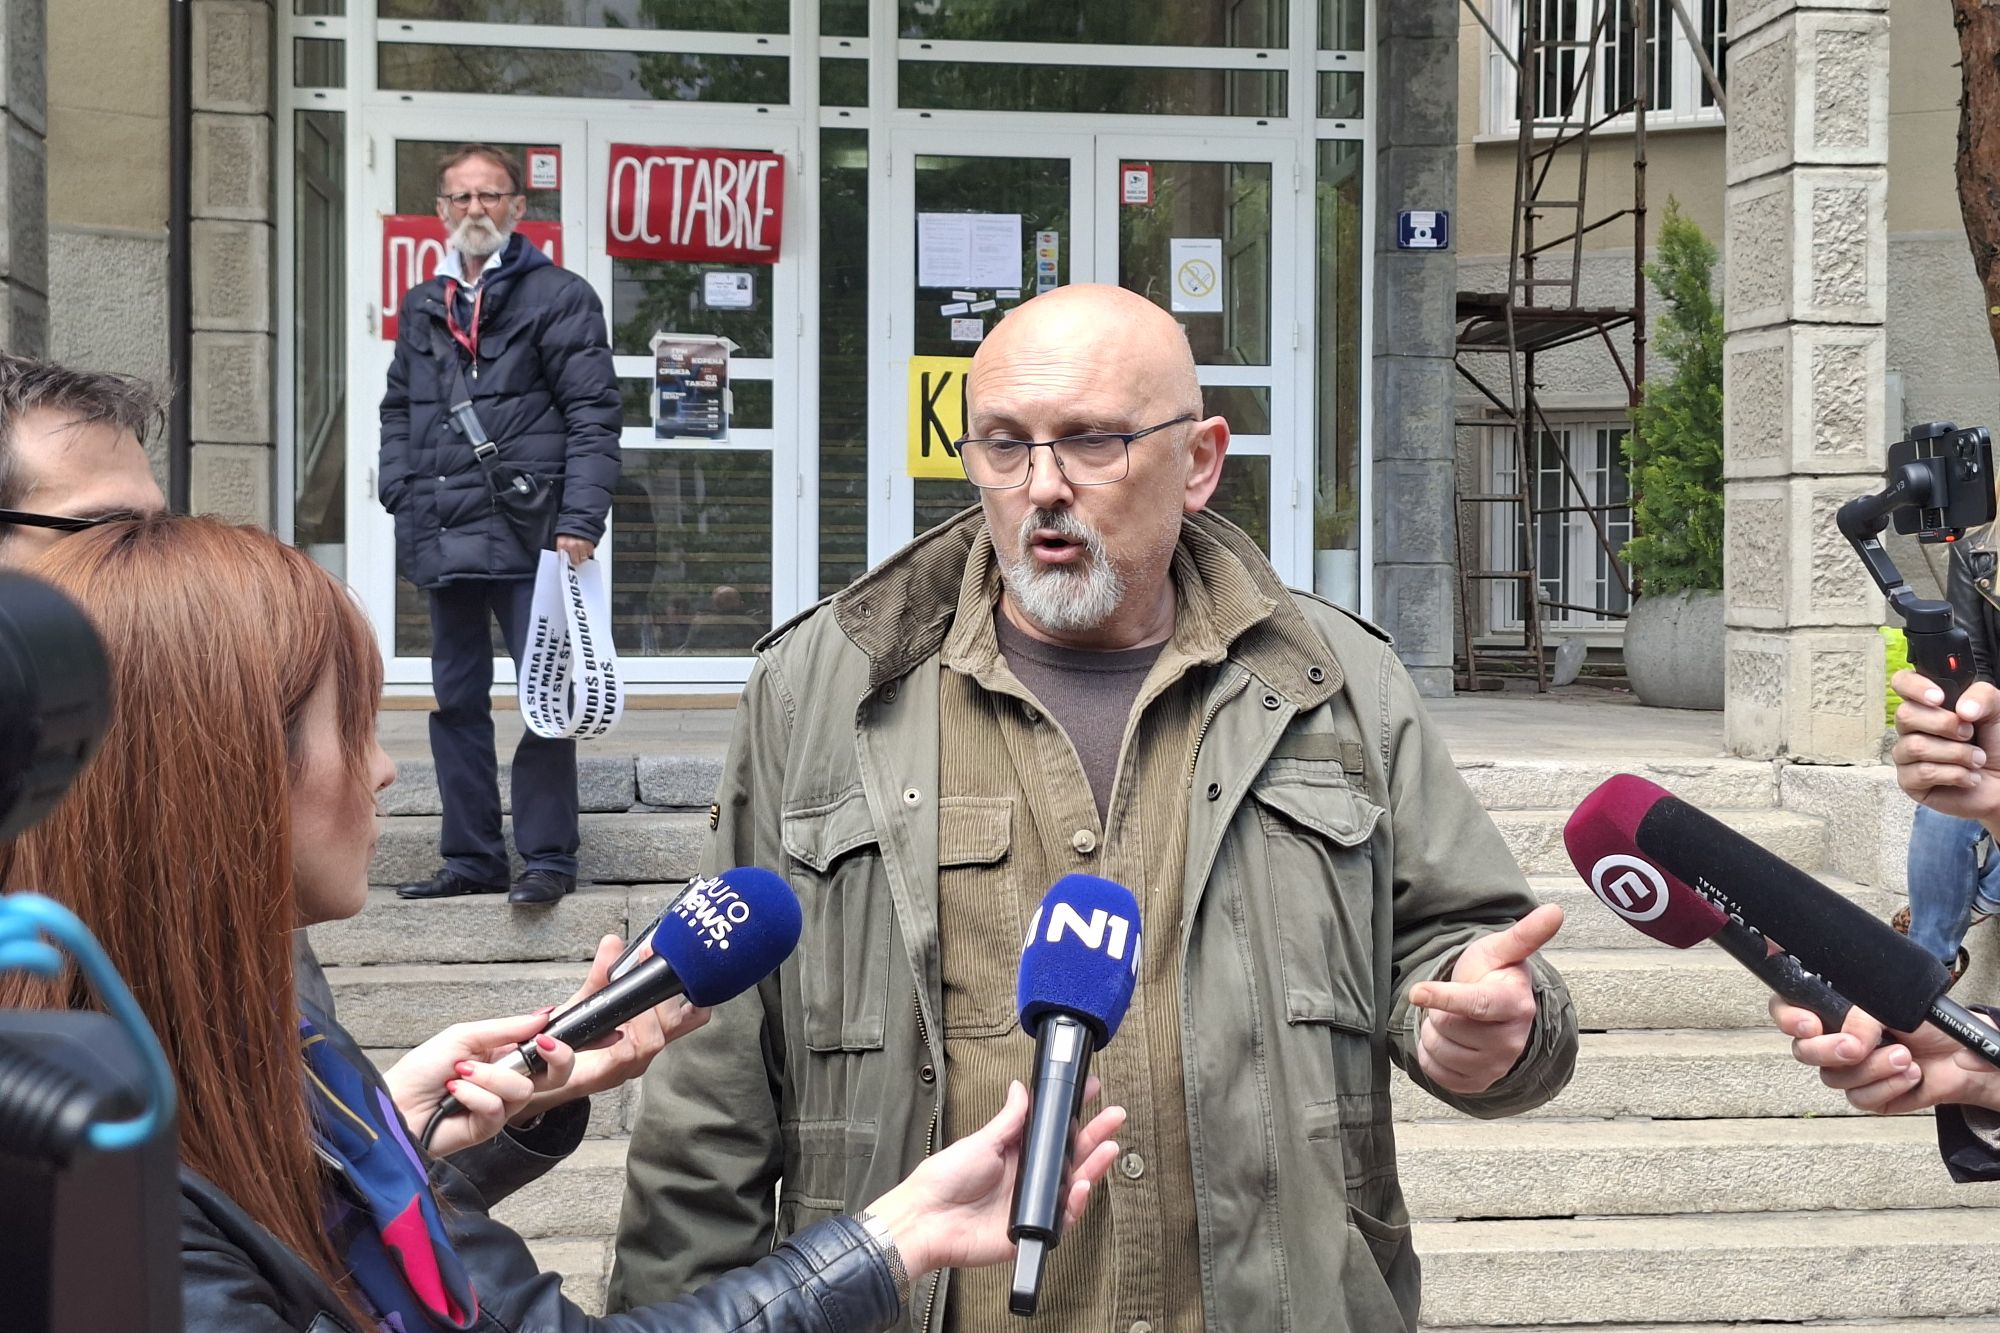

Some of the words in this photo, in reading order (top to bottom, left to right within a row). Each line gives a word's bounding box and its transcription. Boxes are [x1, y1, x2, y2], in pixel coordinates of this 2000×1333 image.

[611, 157, 779, 250] ОСТАВКЕ
[527, 652, 542, 705] SUTRA
[535, 615, 548, 648] NIJE
[553, 663, 567, 693] SVE
[1699, 876, 1728, 902] KANAL
[1730, 902, 1742, 913] TV
[1046, 902, 1129, 960] N1
